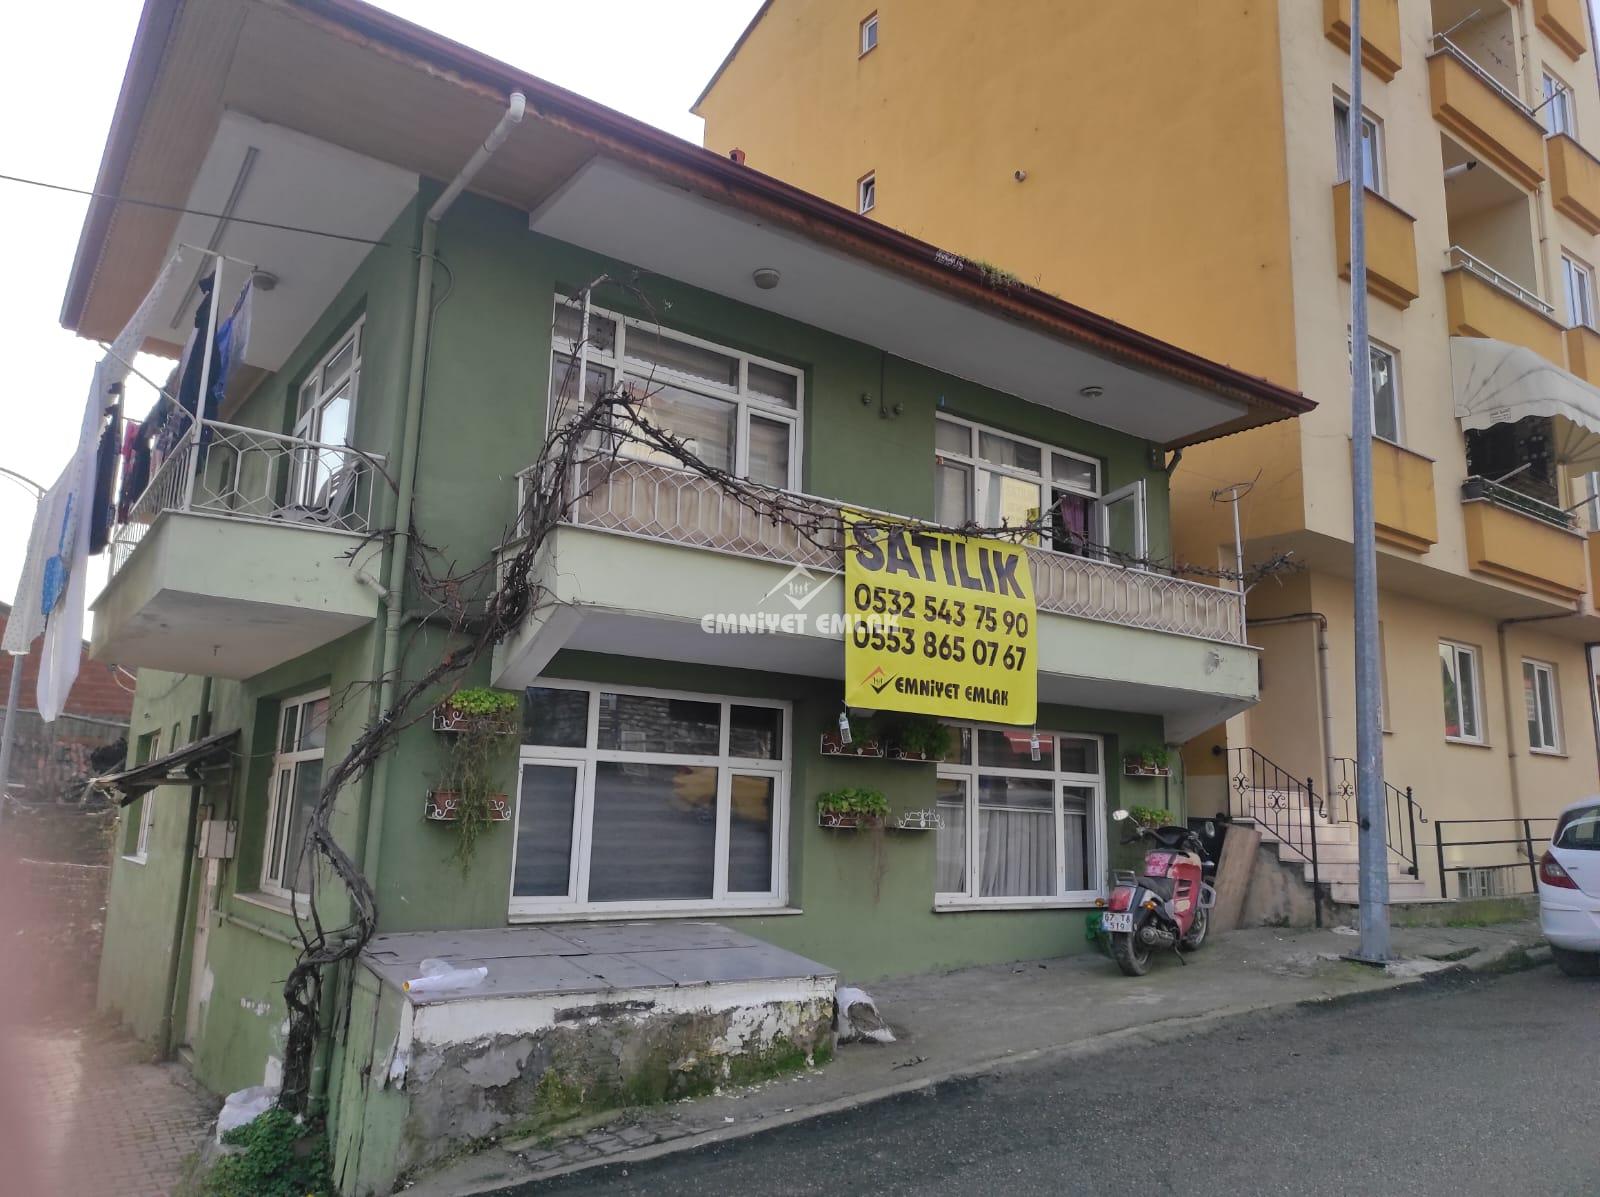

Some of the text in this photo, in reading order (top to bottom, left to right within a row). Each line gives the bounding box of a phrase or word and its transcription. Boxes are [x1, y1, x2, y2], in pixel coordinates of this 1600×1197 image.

[852, 520, 1026, 600] SATILIK
[854, 583, 1029, 639] 0532 543 75 90
[853, 620, 1027, 672] 0553 865 07 67
[965, 685, 1009, 707] EMLAK
